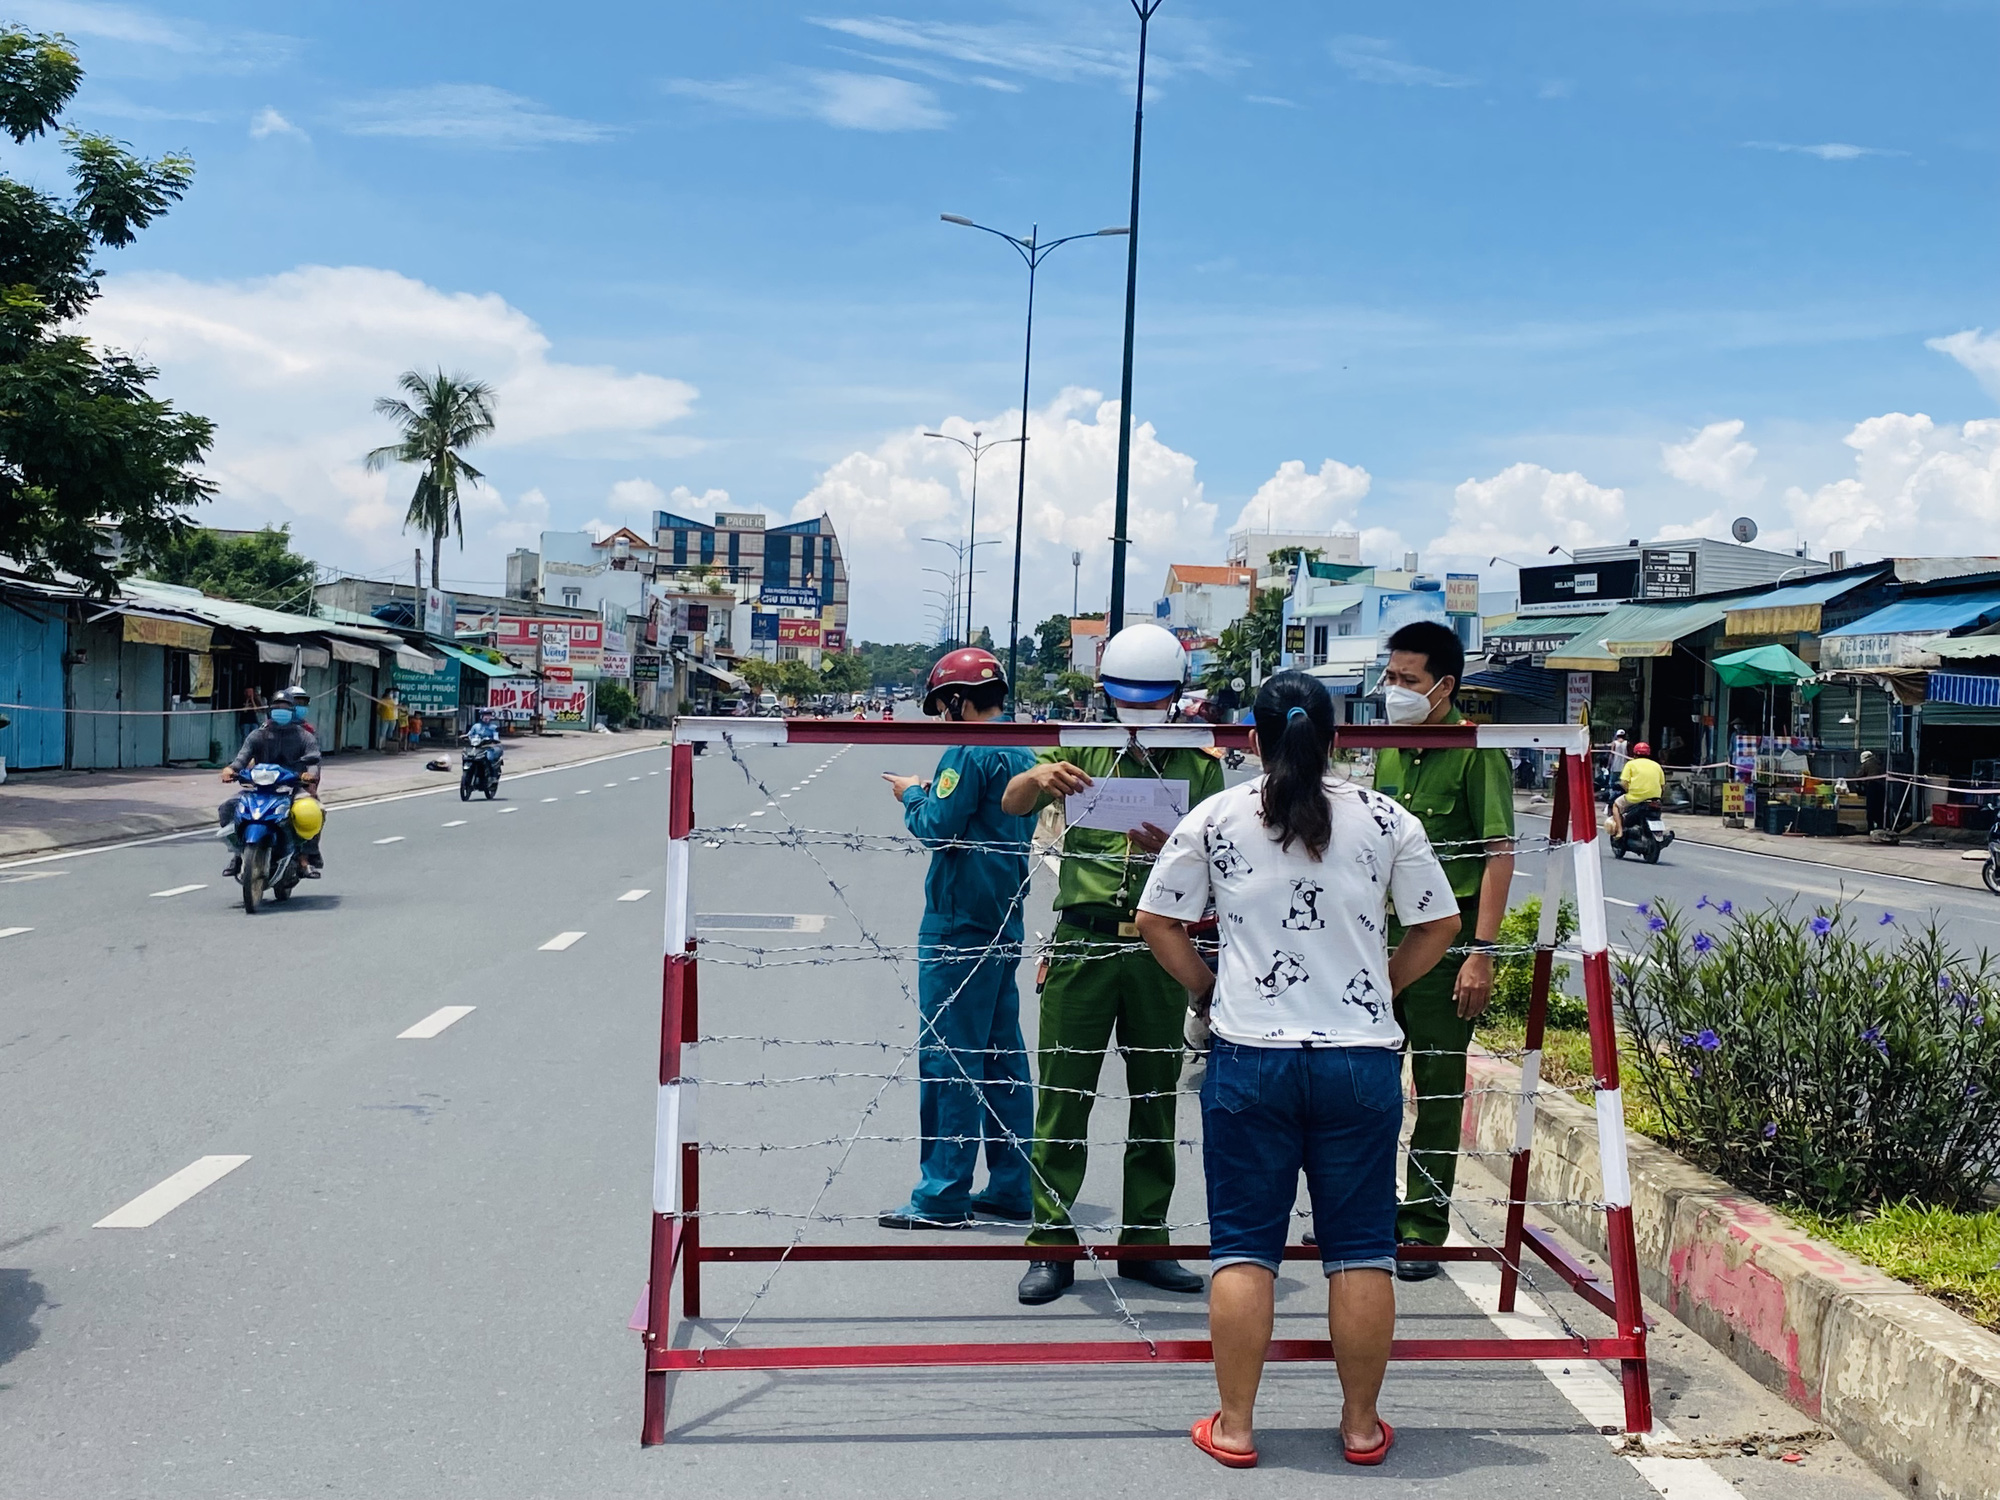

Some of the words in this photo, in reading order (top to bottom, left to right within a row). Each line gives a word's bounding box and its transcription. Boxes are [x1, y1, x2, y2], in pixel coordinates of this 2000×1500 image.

[726, 516, 765, 528] PACIFIC
[1657, 573, 1680, 583] 512
[1554, 581, 1574, 589] MILANO
[780, 596, 797, 604] KIM
[1501, 639, 1513, 652] CÀ
[1515, 638, 1534, 652] PHÊ
[490, 683, 517, 709] RỬA
